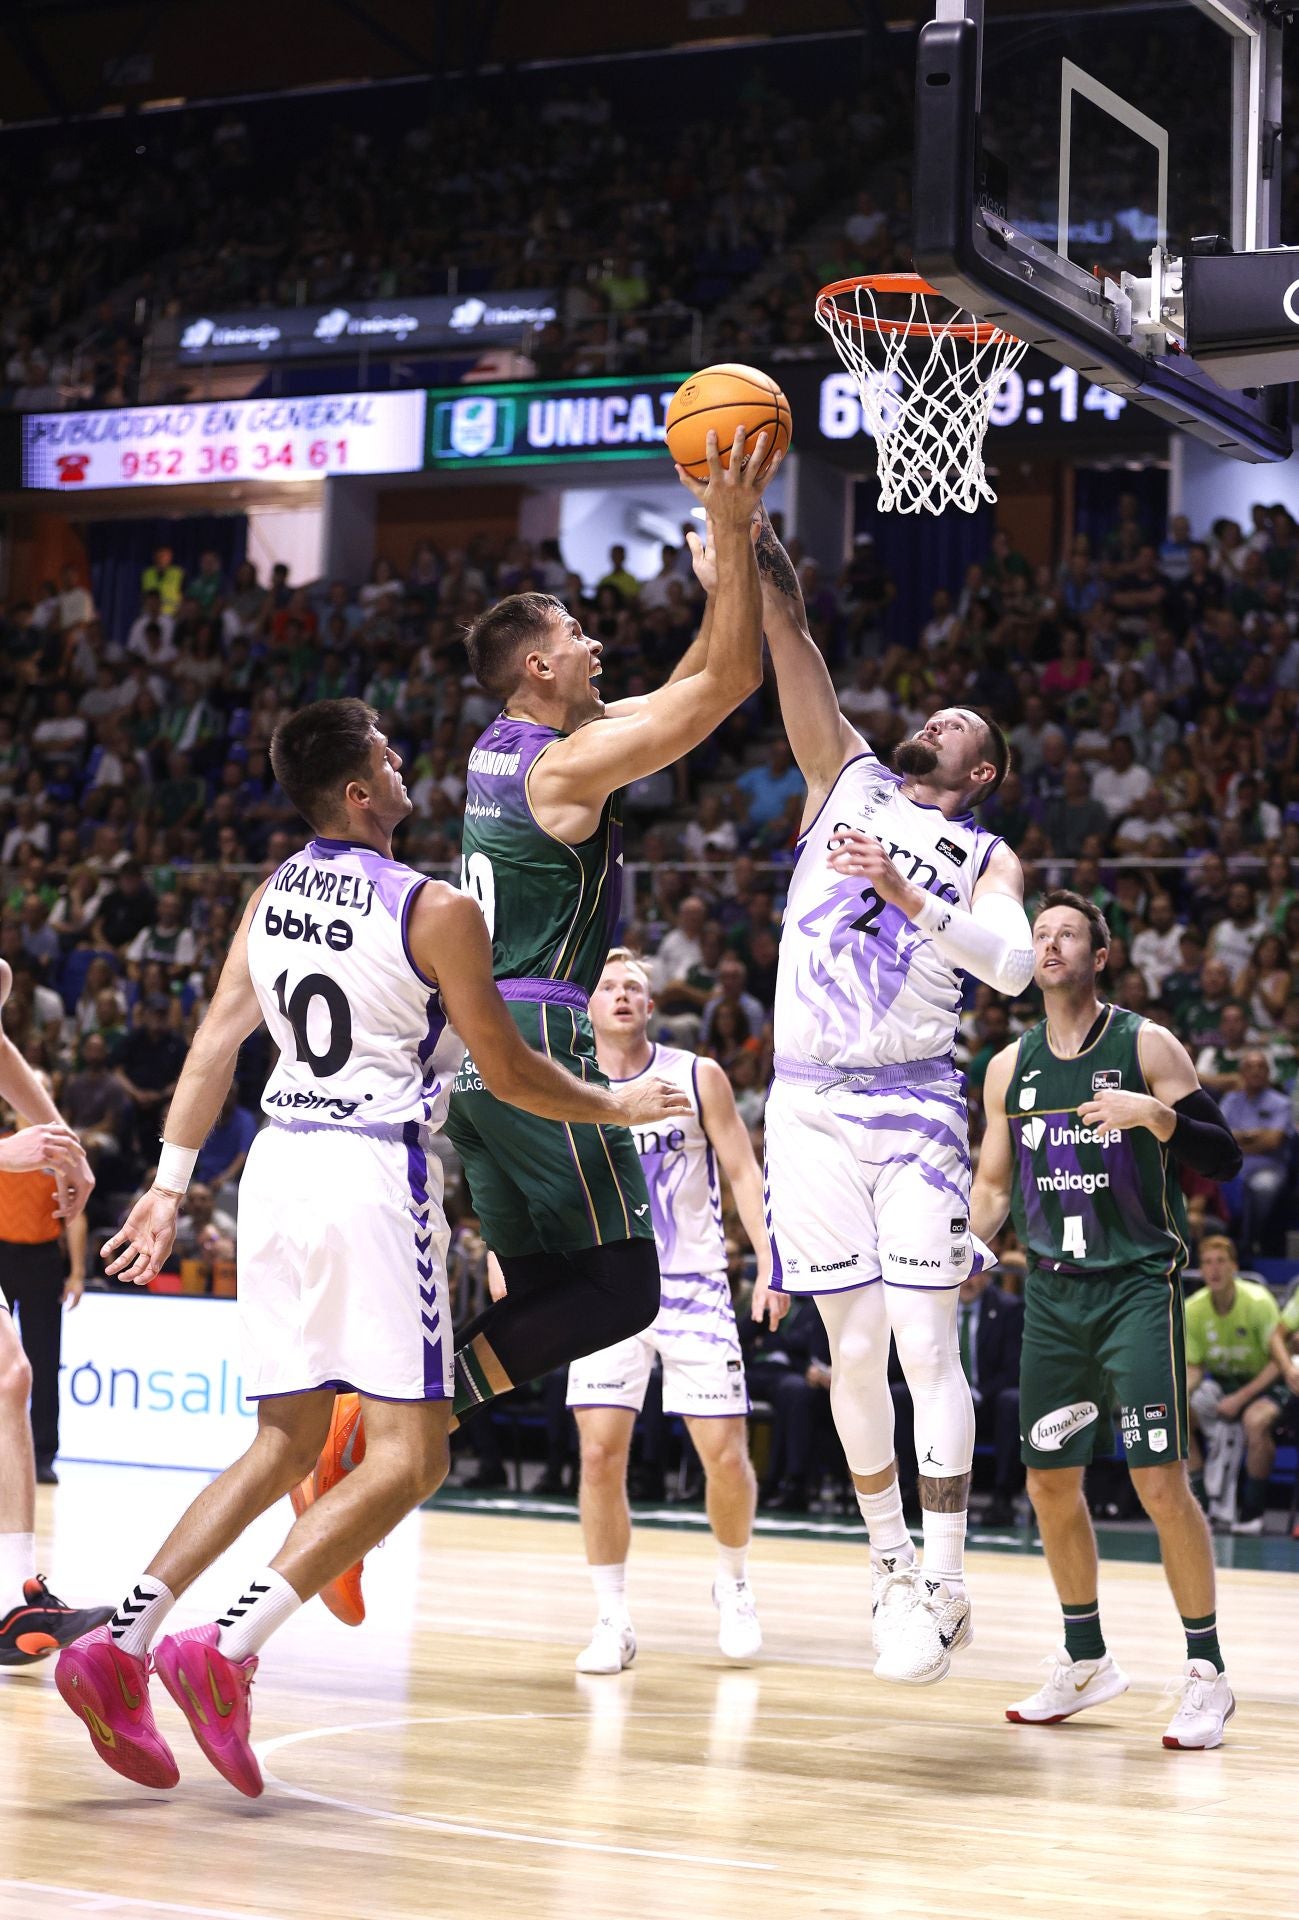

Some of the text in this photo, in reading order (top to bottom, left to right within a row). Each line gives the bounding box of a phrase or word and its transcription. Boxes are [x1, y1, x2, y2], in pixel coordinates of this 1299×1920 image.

[31, 400, 377, 445] PUBLICIDAD EN GENERAL
[122, 439, 347, 479] 952 36 34 61
[850, 887, 887, 938] 2
[272, 968, 353, 1078] 10
[452, 1077, 487, 1093] ÁLAG
[1050, 1124, 1122, 1149] Unicaja
[1062, 1216, 1087, 1259] 4
[889, 1253, 941, 1268] NISSAN
[58, 1359, 258, 1417] ónsalu
[1146, 1410, 1163, 1418] acb
